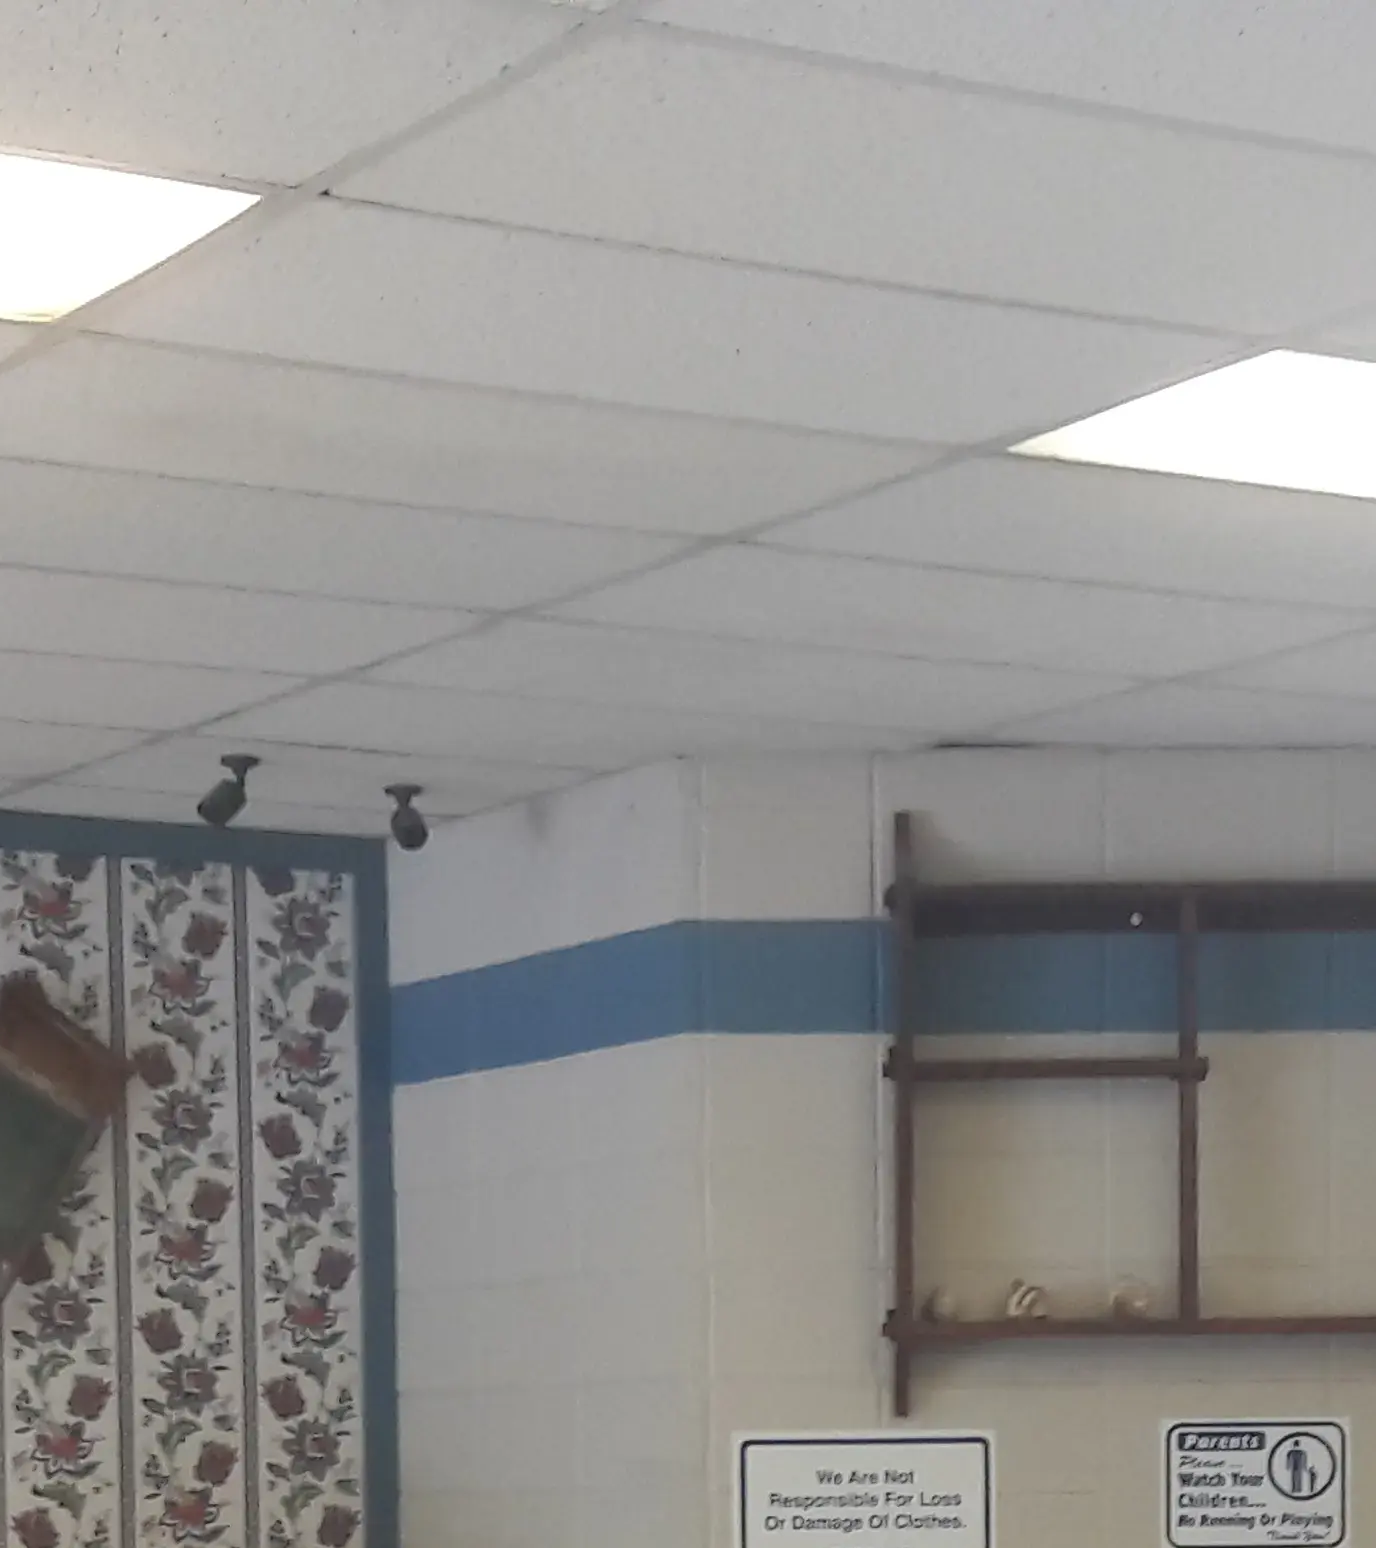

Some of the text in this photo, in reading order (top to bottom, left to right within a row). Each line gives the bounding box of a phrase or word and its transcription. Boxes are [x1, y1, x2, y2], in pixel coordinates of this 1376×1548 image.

[1183, 1433, 1262, 1449] Parents
[816, 1469, 915, 1485] We Are Not
[1178, 1472, 1265, 1488] Watch Your
[769, 1492, 962, 1511] Responsible For Loss
[764, 1516, 786, 1531] Or
[792, 1515, 864, 1533] Damage
[869, 1514, 889, 1530] Of
[1178, 1511, 1334, 1530] No Running Or Playing
